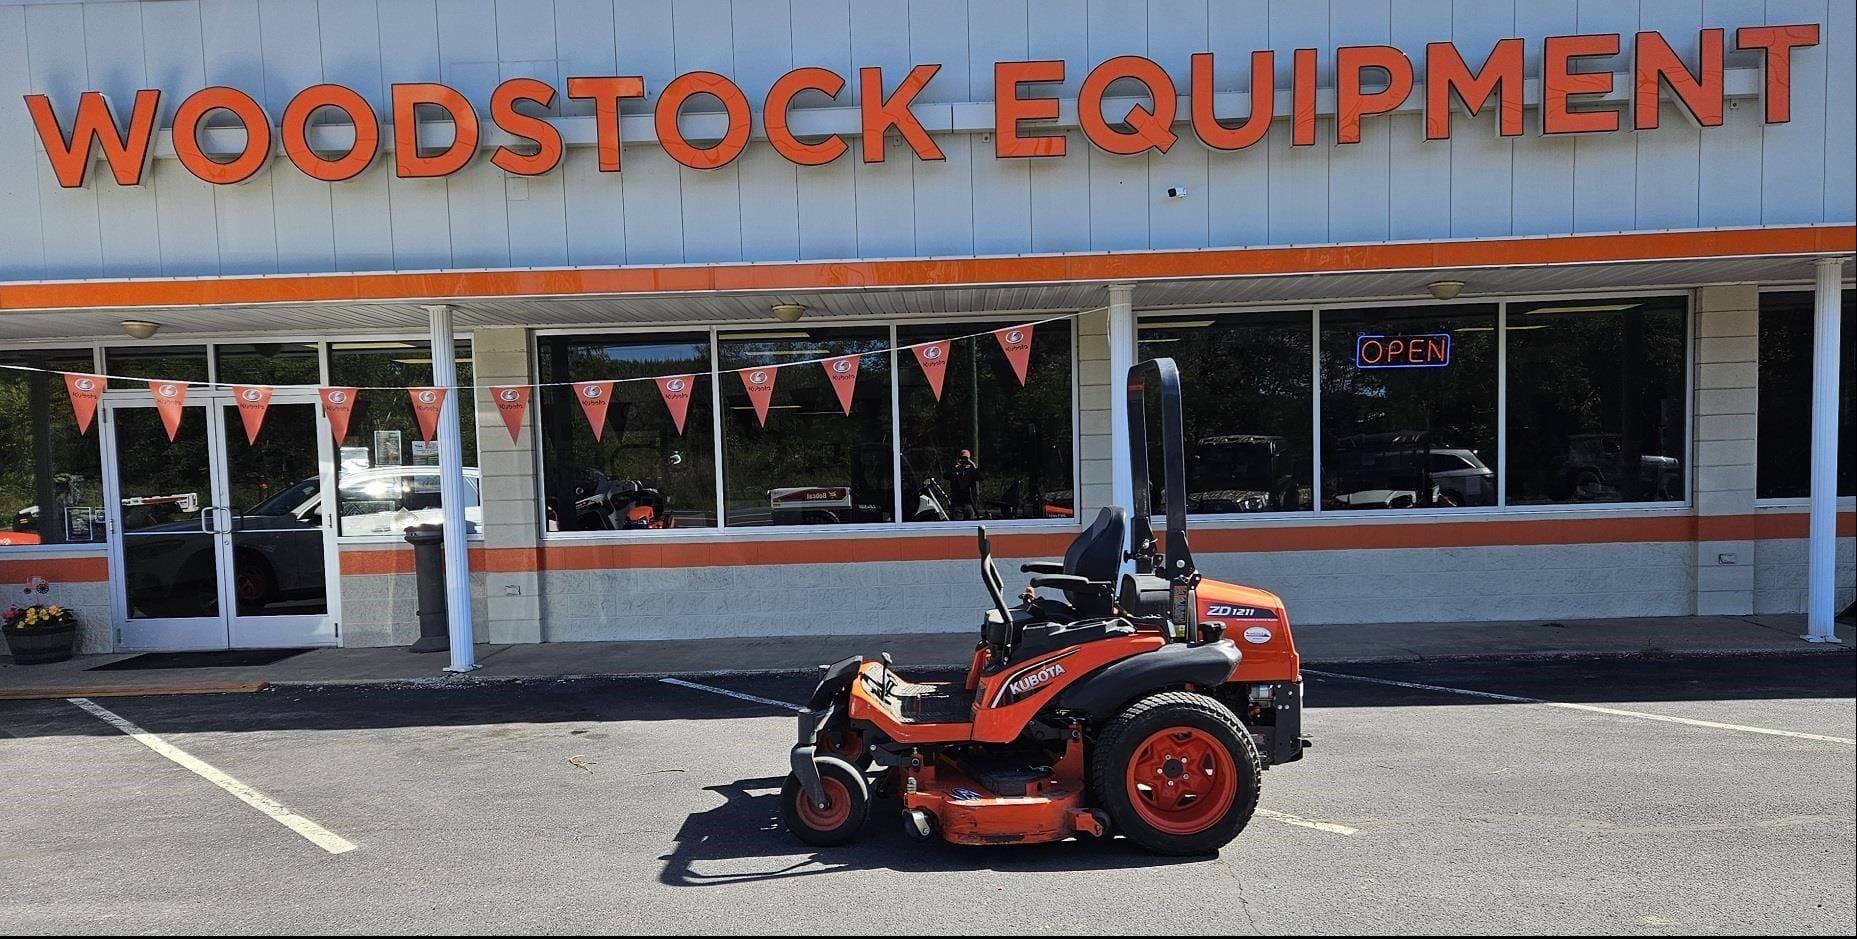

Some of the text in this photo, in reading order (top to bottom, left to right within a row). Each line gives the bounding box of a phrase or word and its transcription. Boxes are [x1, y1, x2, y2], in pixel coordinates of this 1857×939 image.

[24, 24, 1821, 188] WOODSTOCK EQUIPMENT
[1006, 344, 1028, 352] Kubota
[1361, 338, 1445, 364] OPEN
[924, 359, 946, 367] Kubota
[833, 372, 855, 380] Kubota
[666, 393, 689, 401] Kubota
[583, 398, 607, 406] Kubota
[1206, 605, 1255, 616] ZD 1211
[1009, 663, 1066, 695] KUBOTA
